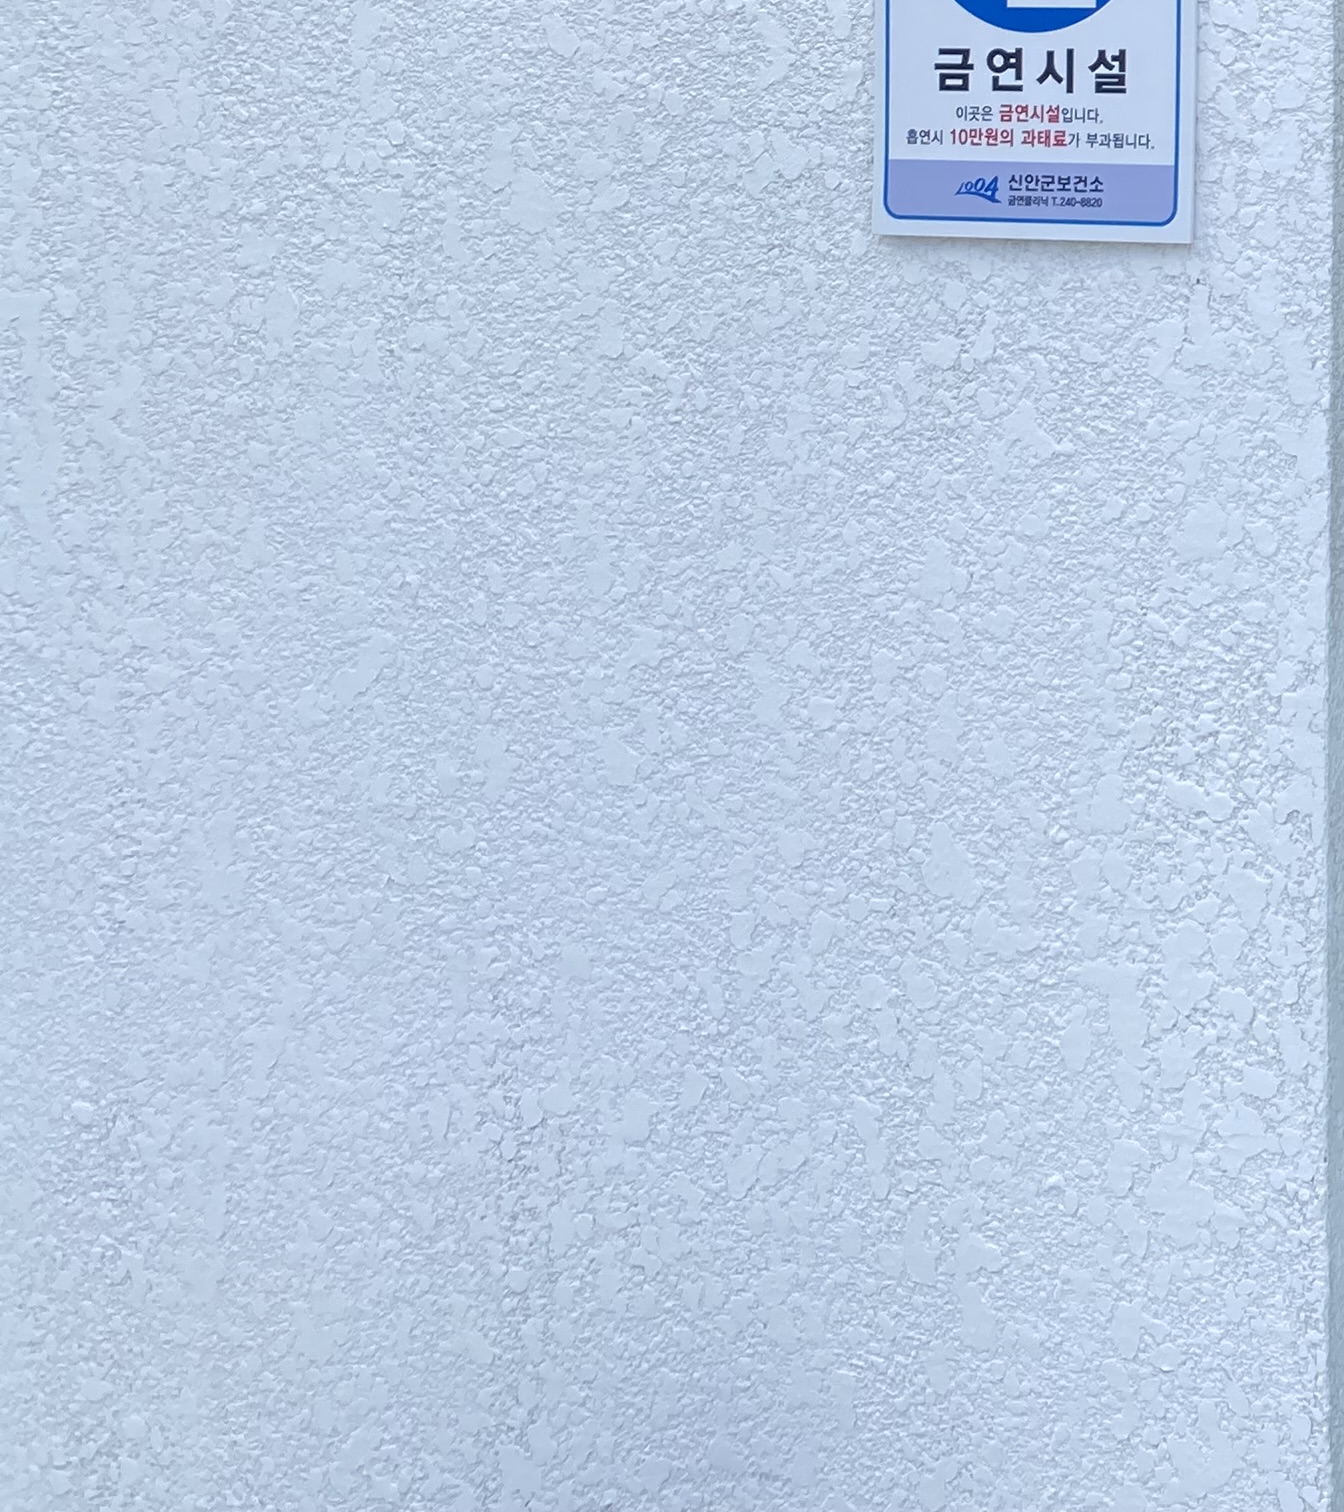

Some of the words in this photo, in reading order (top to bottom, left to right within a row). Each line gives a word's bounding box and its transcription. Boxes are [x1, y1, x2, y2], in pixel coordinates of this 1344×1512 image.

[934, 47, 1127, 94] 금연시설
[956, 105, 993, 122] 이곳은
[999, 104, 1103, 124] 금연시설입니다.
[906, 128, 944, 145] 흡연시
[950, 127, 1014, 148] 10만원의
[1021, 129, 1080, 148] 과태료가
[1085, 132, 1155, 150] 부과됩니다.
[1008, 174, 1104, 193] 신안군보건소
[1008, 194, 1049, 207] 금연클리닉
[1051, 196, 1103, 208] T.240-8820
